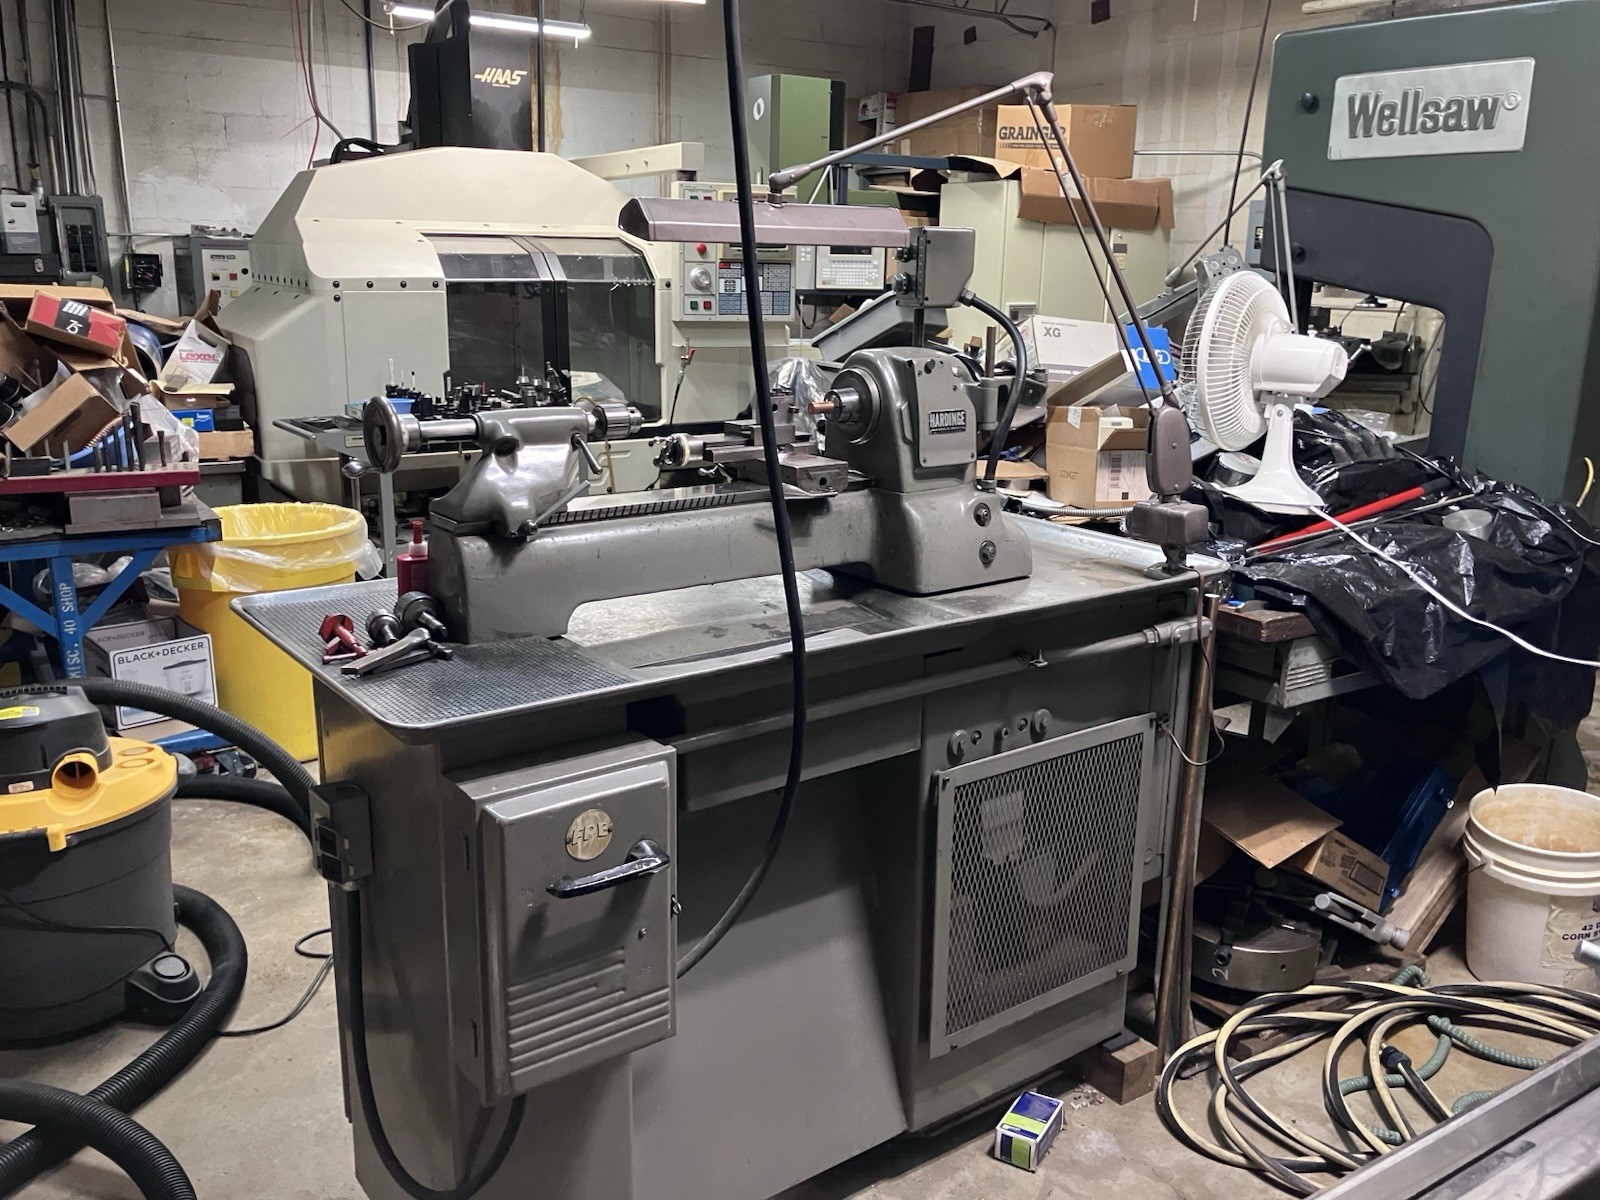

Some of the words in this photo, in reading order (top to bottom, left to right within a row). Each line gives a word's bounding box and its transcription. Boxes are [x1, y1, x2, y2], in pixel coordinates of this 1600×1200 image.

[474, 67, 528, 86] HAAS
[1043, 326, 1062, 338] XG
[930, 411, 966, 428] HARDINGE
[58, 582, 75, 613] SHOP
[63, 619, 77, 635] 40
[117, 641, 205, 665] BLACK+DECKER
[1562, 932, 1591, 940] CORN
